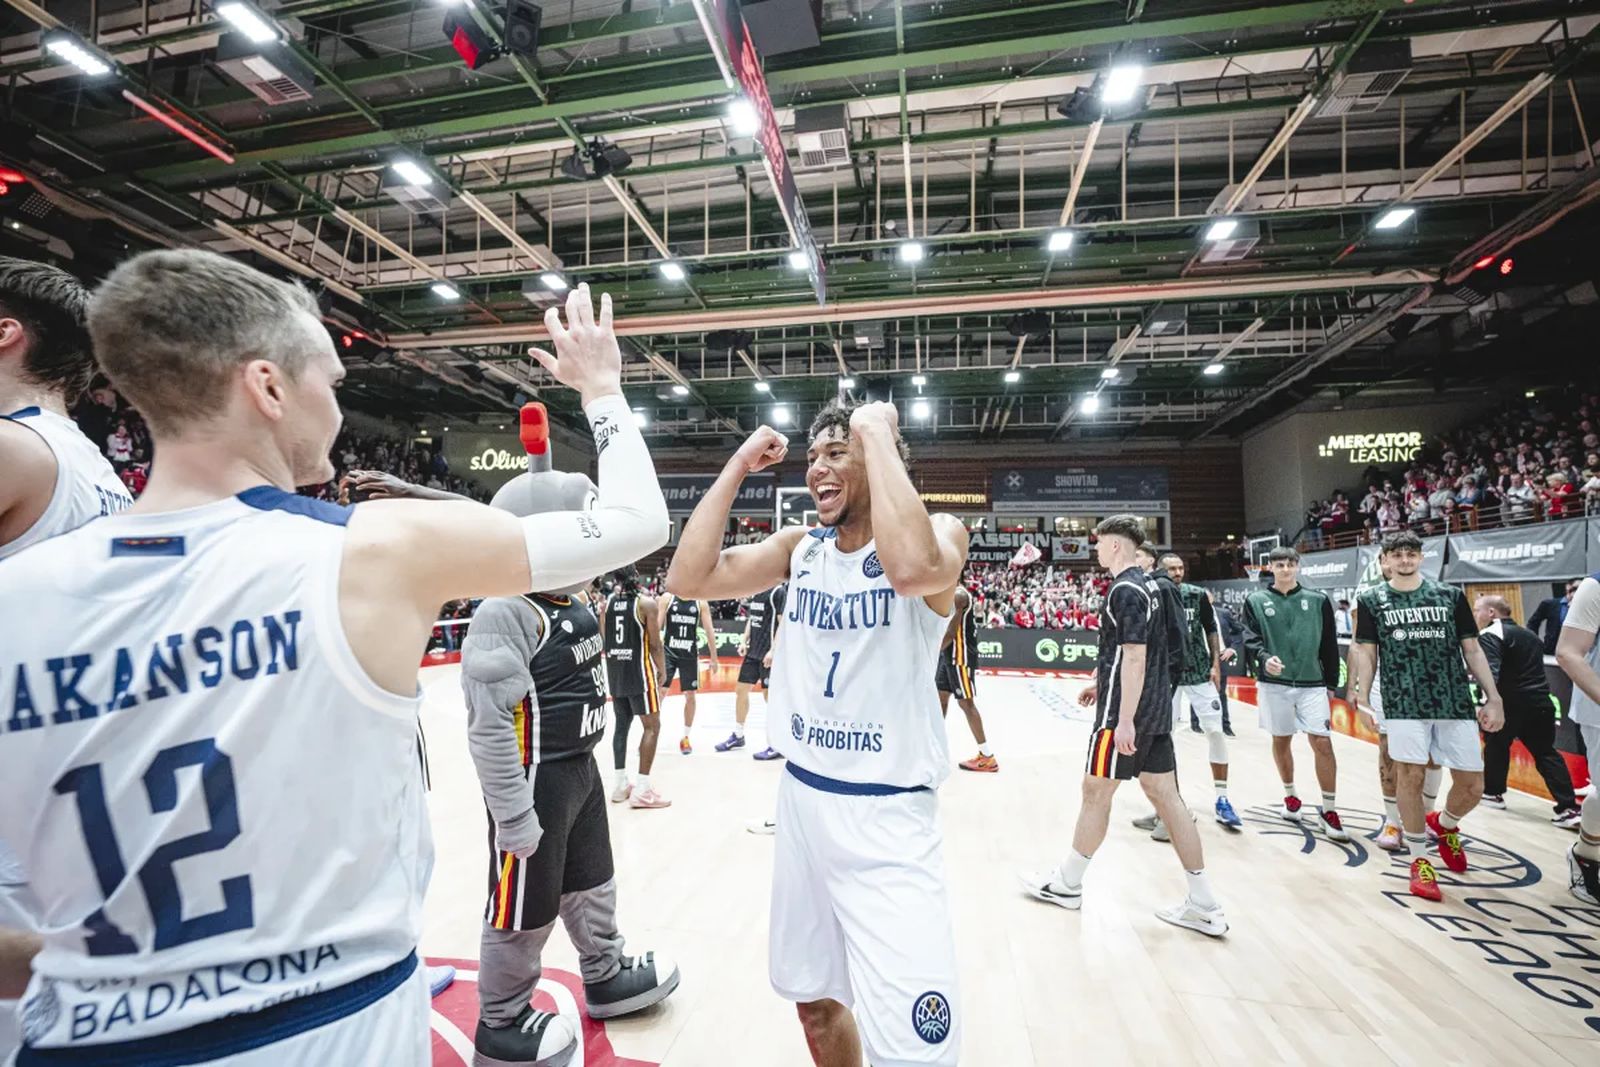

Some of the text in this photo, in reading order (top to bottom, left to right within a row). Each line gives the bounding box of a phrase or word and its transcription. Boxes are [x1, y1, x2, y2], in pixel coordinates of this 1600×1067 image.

[1327, 432, 1421, 449] MERCATOR
[470, 448, 529, 470] s.Olive
[1055, 475, 1098, 487] SHOWTAG
[969, 532, 1050, 547] ASSION
[1458, 543, 1564, 561] spindler
[789, 587, 895, 630] JOVENTUT
[1383, 607, 1448, 626] JOVENTUT
[615, 616, 624, 644] 5
[679, 625, 687, 638] 11
[0, 610, 302, 735] AKANSON
[823, 651, 841, 698] 1
[807, 727, 883, 753] PROBITAS
[52, 737, 254, 957] 12
[70, 943, 341, 1042] BADALONA
